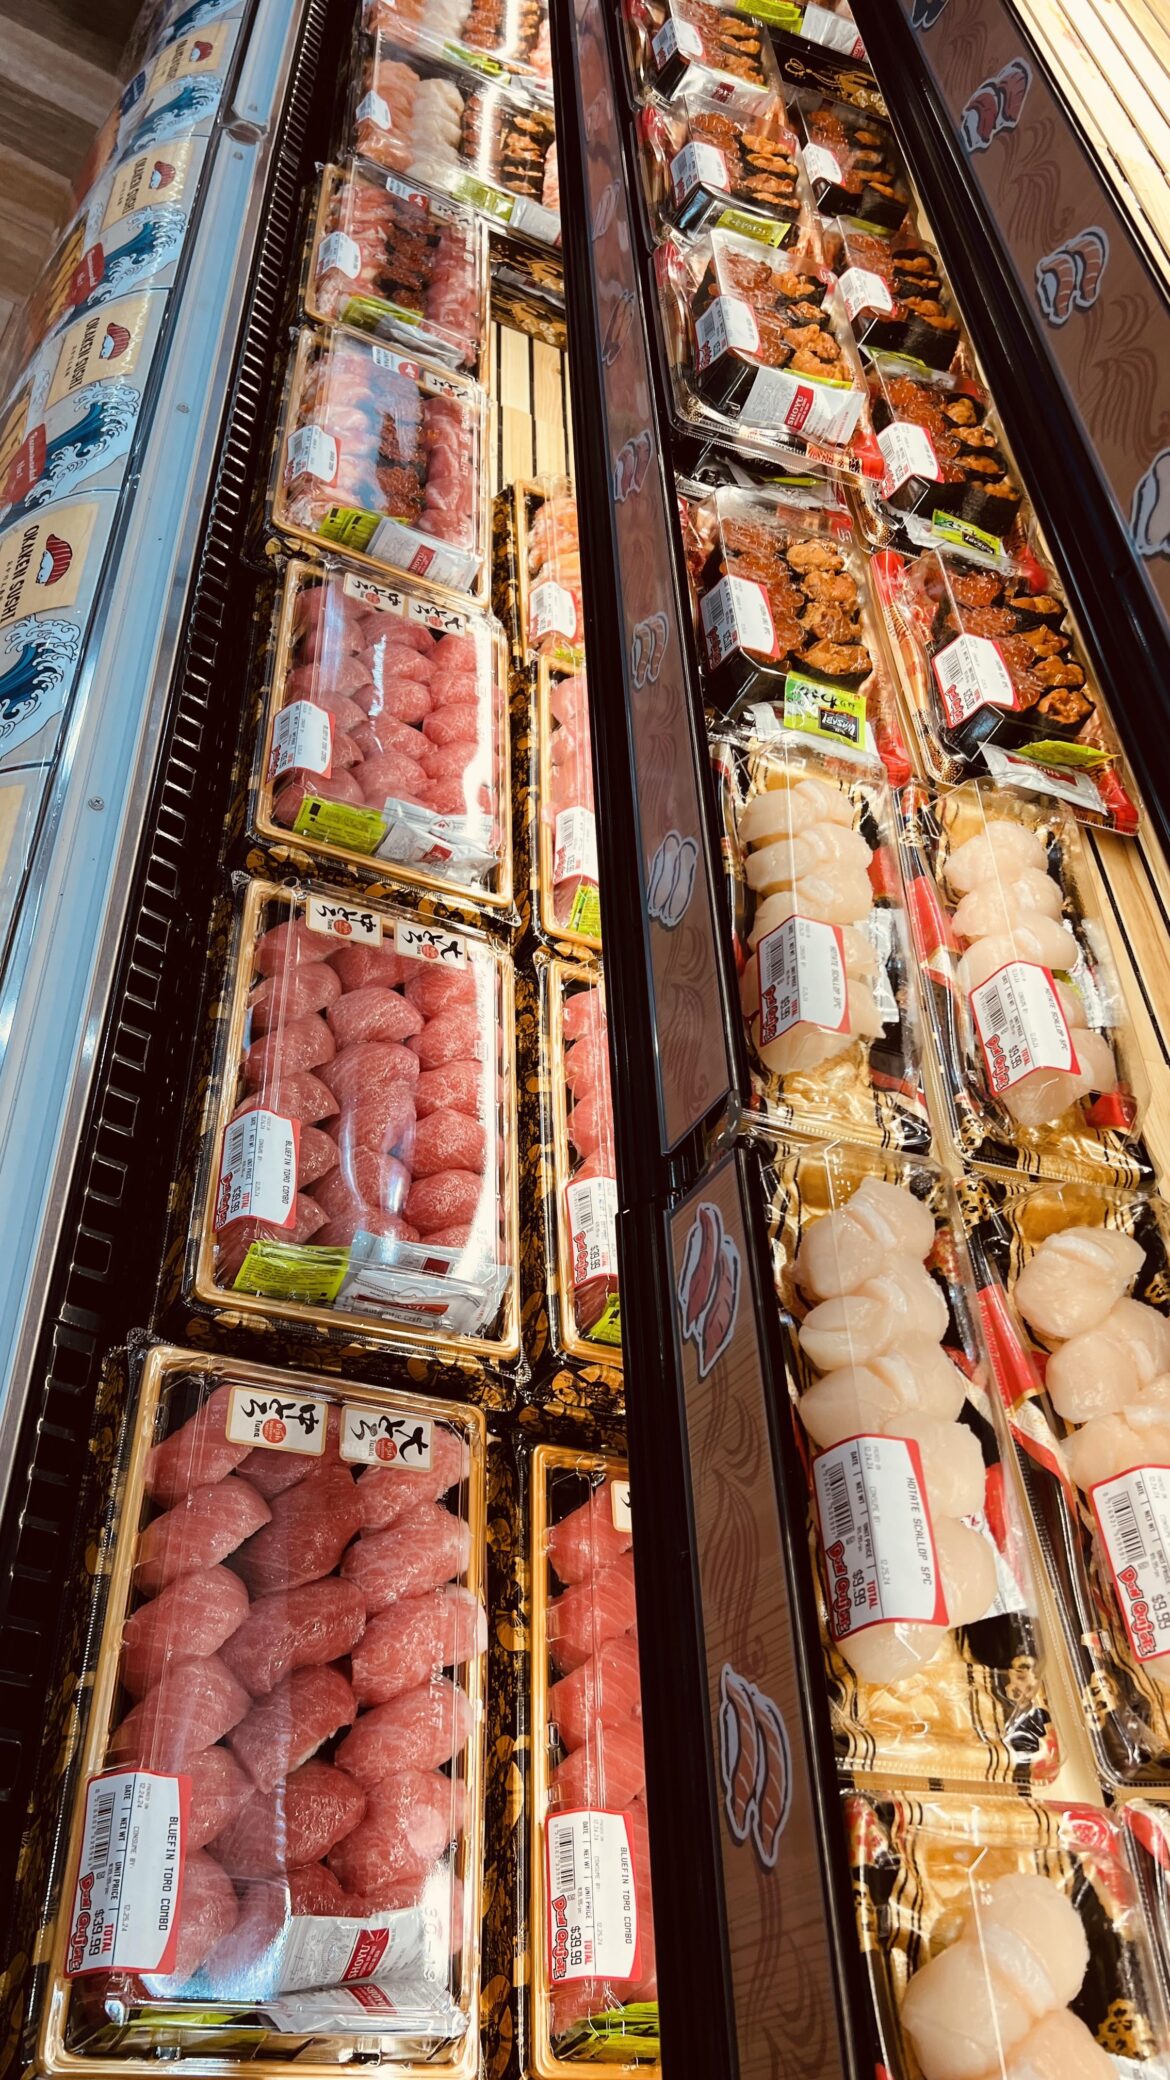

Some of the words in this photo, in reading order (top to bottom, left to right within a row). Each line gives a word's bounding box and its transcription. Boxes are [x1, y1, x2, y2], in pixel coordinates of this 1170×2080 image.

[77, 317, 100, 360] OKAKEN
[68, 357, 89, 391] SUSHI
[787, 396, 805, 425] SHOYU
[13, 525, 40, 580] OKAKEN
[1, 578, 25, 622] SUSHI
[821, 713, 856, 736] WASABI
[316, 905, 377, 933] 中とろ
[401, 930, 463, 960] 大とろ
[1009, 1044, 1023, 1069] $9.99
[1020, 1048, 1031, 1066] TOTAL
[285, 1140, 293, 1166] BLUEFIN
[283, 1168, 291, 1183] TORO
[240, 1398, 319, 1435] 中とろ
[253, 1420, 263, 1438] Tuna
[350, 1415, 429, 1462] 大とろ
[368, 1439, 377, 1457] Tuna
[850, 1451, 859, 1466] DATE
[858, 1494, 865, 1505] WT
[1134, 1481, 1145, 1496] DATE
[862, 1522, 870, 1536] UNIT
[906, 1477, 920, 1513] HOTATE
[913, 1518, 928, 1561] SCALLOP
[865, 1537, 873, 1559] PRICE
[852, 1568, 867, 1608] $9.99
[866, 1580, 878, 1610] TOTAL
[1151, 1593, 1170, 1631] $9.99
[123, 1784, 132, 1801] DATE
[136, 1782, 146, 1809] 12.24.24
[117, 1830, 125, 1842] WT
[119, 1817, 128, 1831] NET
[130, 1825, 140, 1854] CONSUME
[164, 1816, 179, 1861] BLUEFIN
[113, 1861, 122, 1876] UNIT
[162, 1866, 174, 1892] TORO
[583, 1860, 590, 1870] WT
[620, 1846, 630, 1885] BLUEFIN
[110, 1877, 120, 1901] PRICE
[622, 1888, 632, 1912] TORO
[121, 1903, 131, 1933] 12.25.24
[158, 1898, 171, 1932] COMBO
[88, 1908, 105, 1957] $39.99
[101, 1922, 114, 1954] TOTAL
[623, 1915, 633, 1945] COMBO
[569, 1925, 582, 1966] $39.99
[583, 1938, 593, 1966] TOTAL
[349, 1944, 371, 1980] SHOYU
